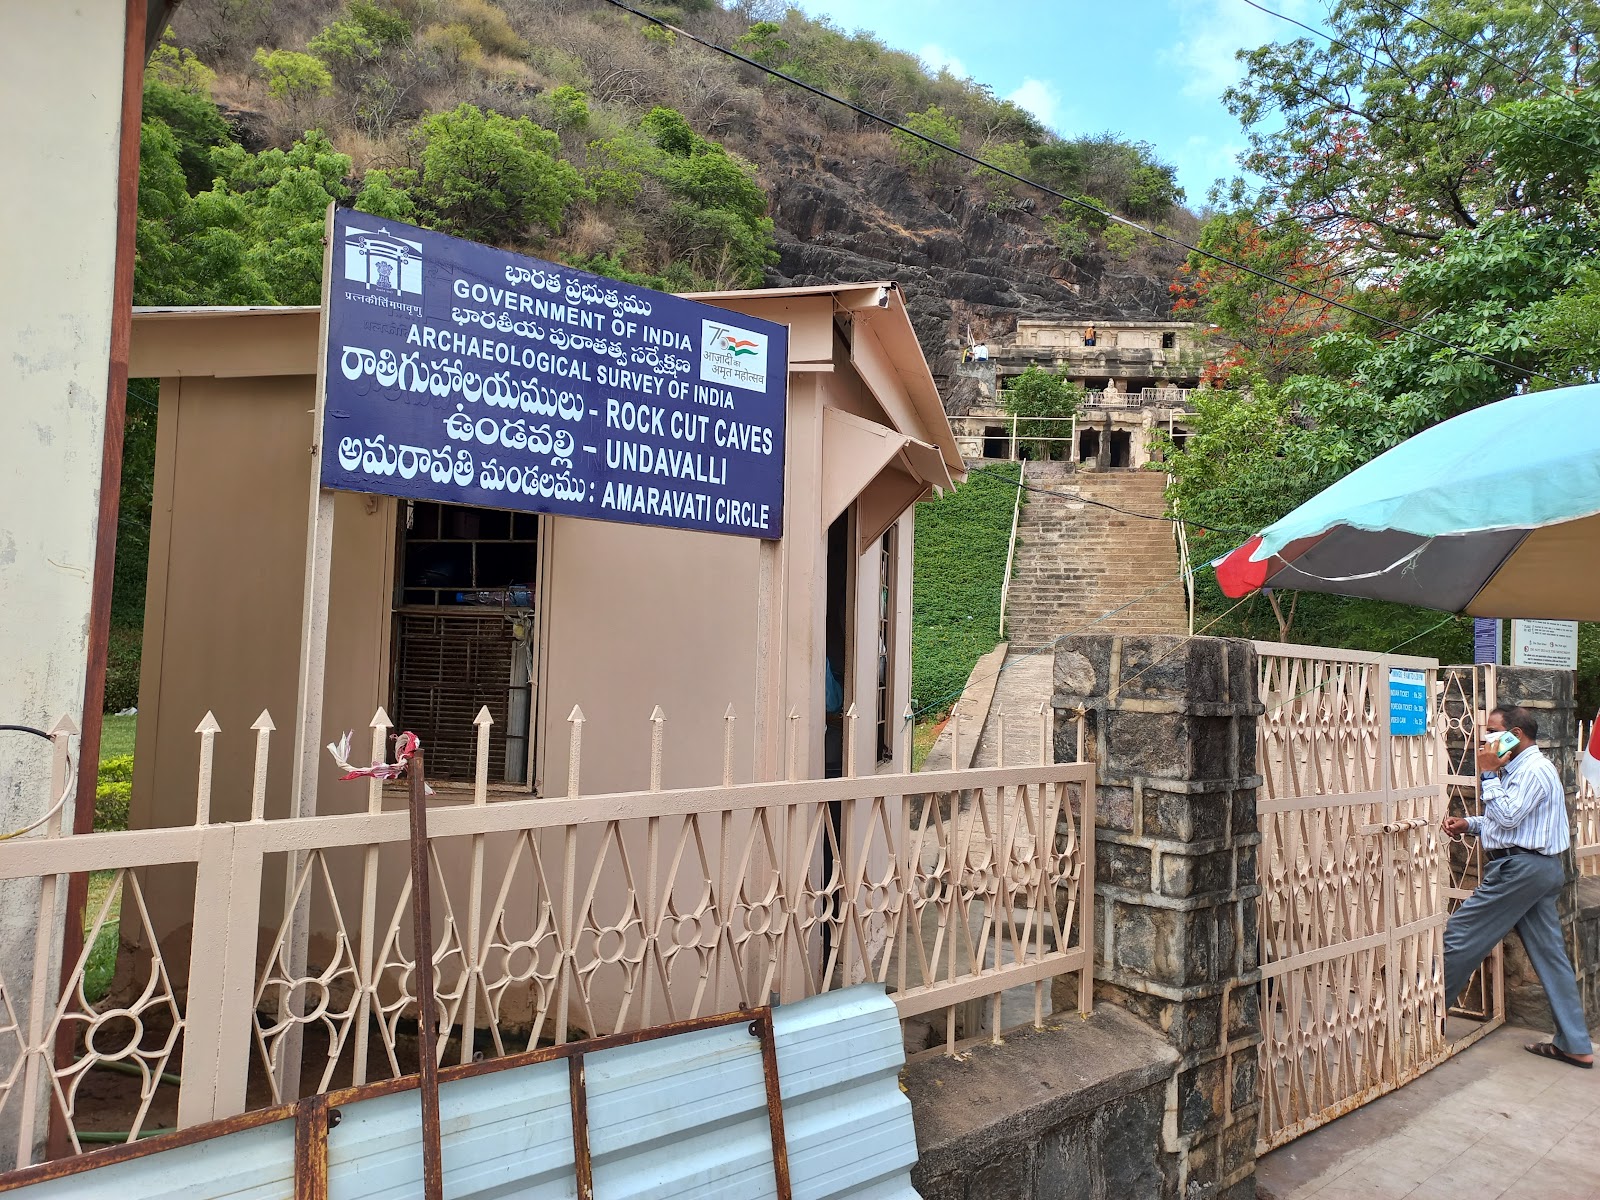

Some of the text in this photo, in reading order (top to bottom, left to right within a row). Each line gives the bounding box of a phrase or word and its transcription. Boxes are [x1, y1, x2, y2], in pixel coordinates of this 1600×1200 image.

[453, 278, 693, 352] GOVERNMENT OF INDIA
[505, 264, 653, 318] భారత ప్రభుత్వము
[406, 323, 735, 410] ARCHAEOLOGICAL SURVEY OF INDIA
[451, 306, 691, 380] భారతీయ పురాతత్వ సర్వేక్షణ
[711, 364, 765, 385] अमृत महोत्सव
[733, 359, 742, 368] का
[340, 345, 584, 422] రాతిగుహాలయములు
[606, 398, 666, 437] ROCK
[670, 410, 710, 444] CUT
[714, 418, 773, 456] CAVES
[442, 403, 575, 469] ఉండవల్లి
[606, 438, 727, 486] UNDAVALLI
[338, 434, 475, 487] అమరావతి
[600, 481, 711, 522] AMARAVATI
[715, 497, 770, 530] CIRCLE
